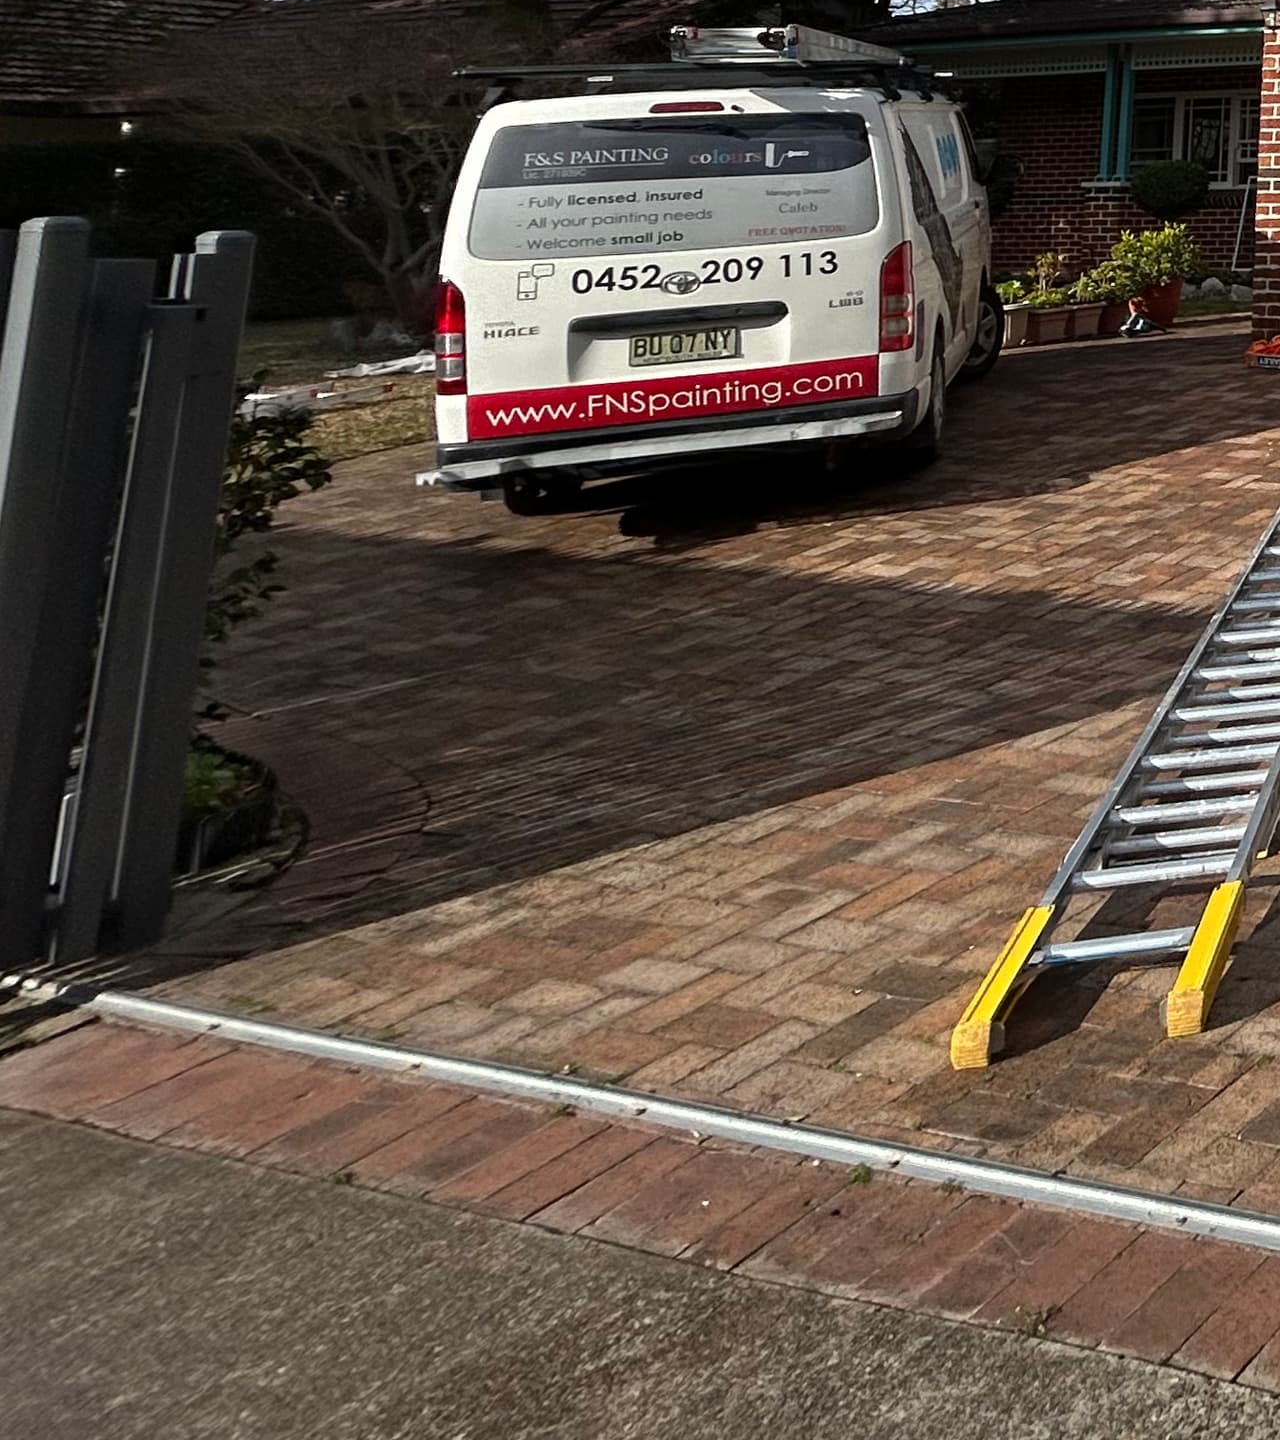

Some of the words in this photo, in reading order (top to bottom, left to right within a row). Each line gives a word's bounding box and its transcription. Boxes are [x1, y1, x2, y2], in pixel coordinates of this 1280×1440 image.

[523, 151, 565, 167] F&S
[570, 147, 669, 165] PAINTING
[689, 149, 762, 165] colours
[528, 196, 564, 209] Fully
[645, 188, 704, 202] insured
[778, 202, 819, 214] Caleb
[526, 217, 547, 229] All
[551, 216, 588, 230] your
[591, 212, 659, 228] painting
[663, 208, 713, 221] needs
[527, 237, 607, 251] Welcome
[610, 232, 654, 245] small
[656, 231, 684, 245] job
[571, 264, 662, 294] 0452
[701, 257, 764, 284] 209
[779, 251, 839, 278] 113
[483, 325, 540, 339] HIACE
[486, 370, 864, 426] www.FNSpainting.com
